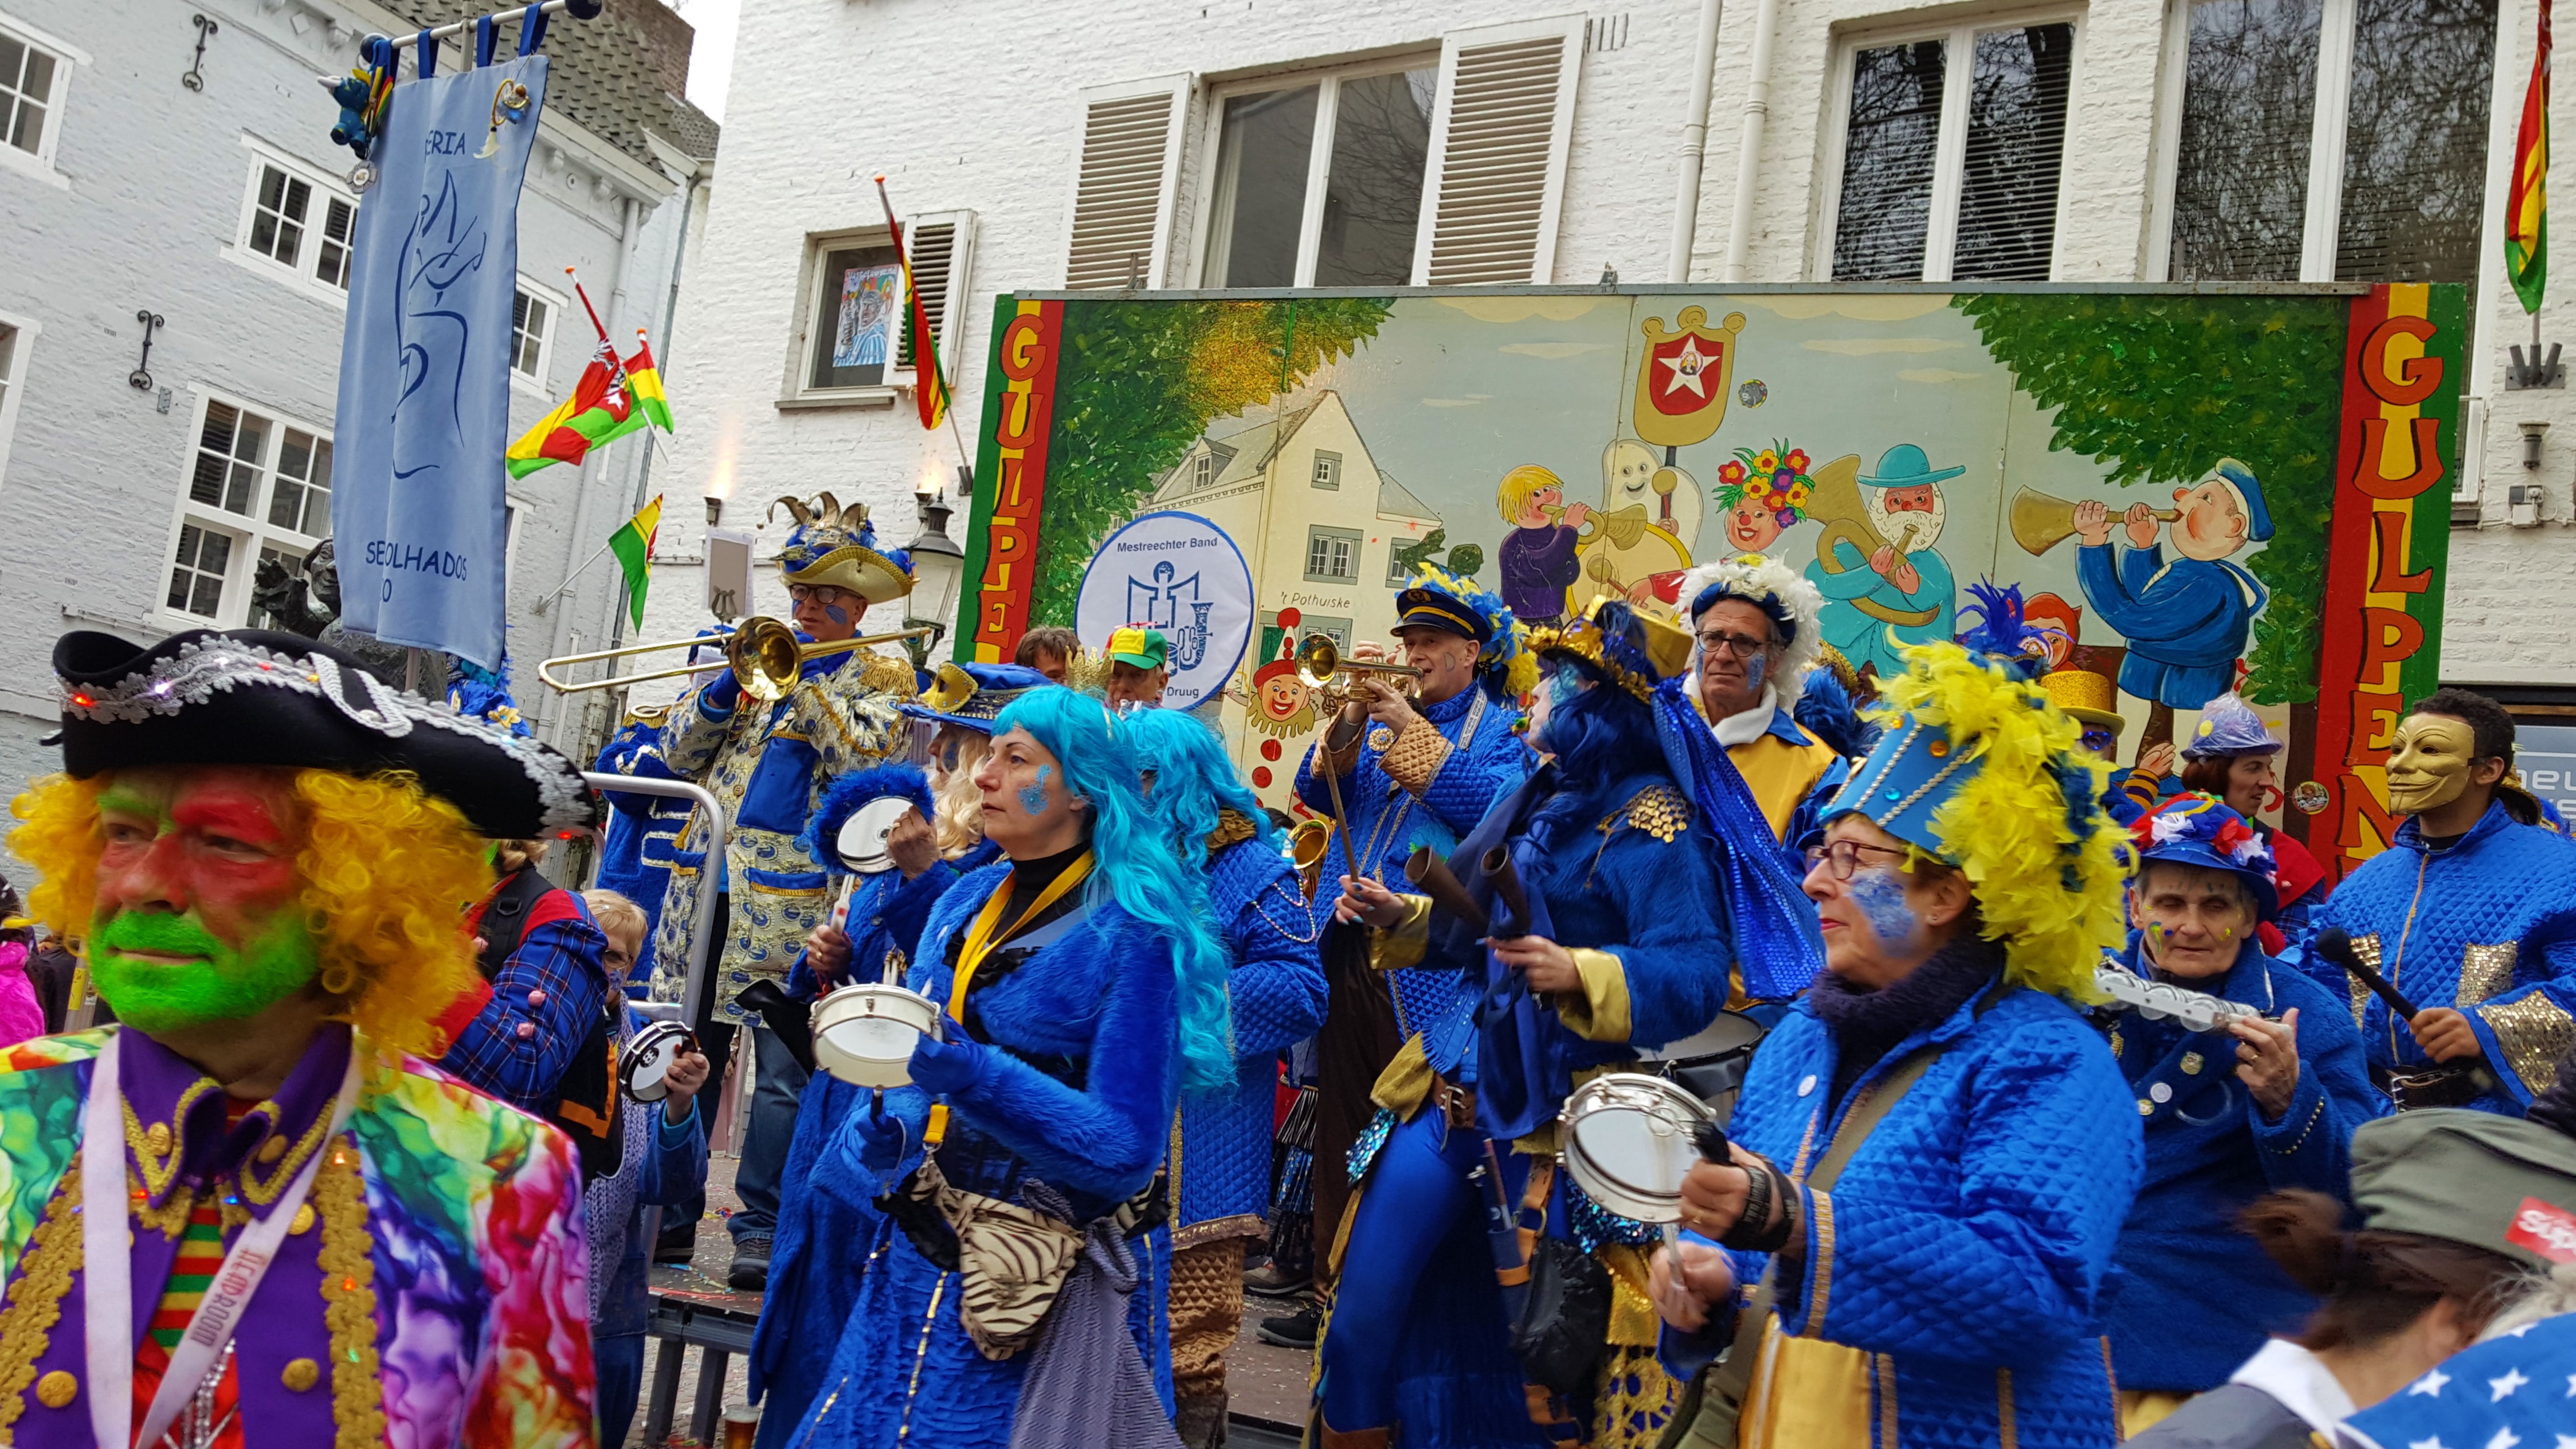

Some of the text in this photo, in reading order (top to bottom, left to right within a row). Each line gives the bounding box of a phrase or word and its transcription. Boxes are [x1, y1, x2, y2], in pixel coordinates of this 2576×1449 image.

[1117, 537, 1218, 553] Mestreechter Band
[2335, 315, 2445, 884] GULPEN
[1167, 686, 1199, 699] Druug
[2518, 1209, 2576, 1255] Sup
